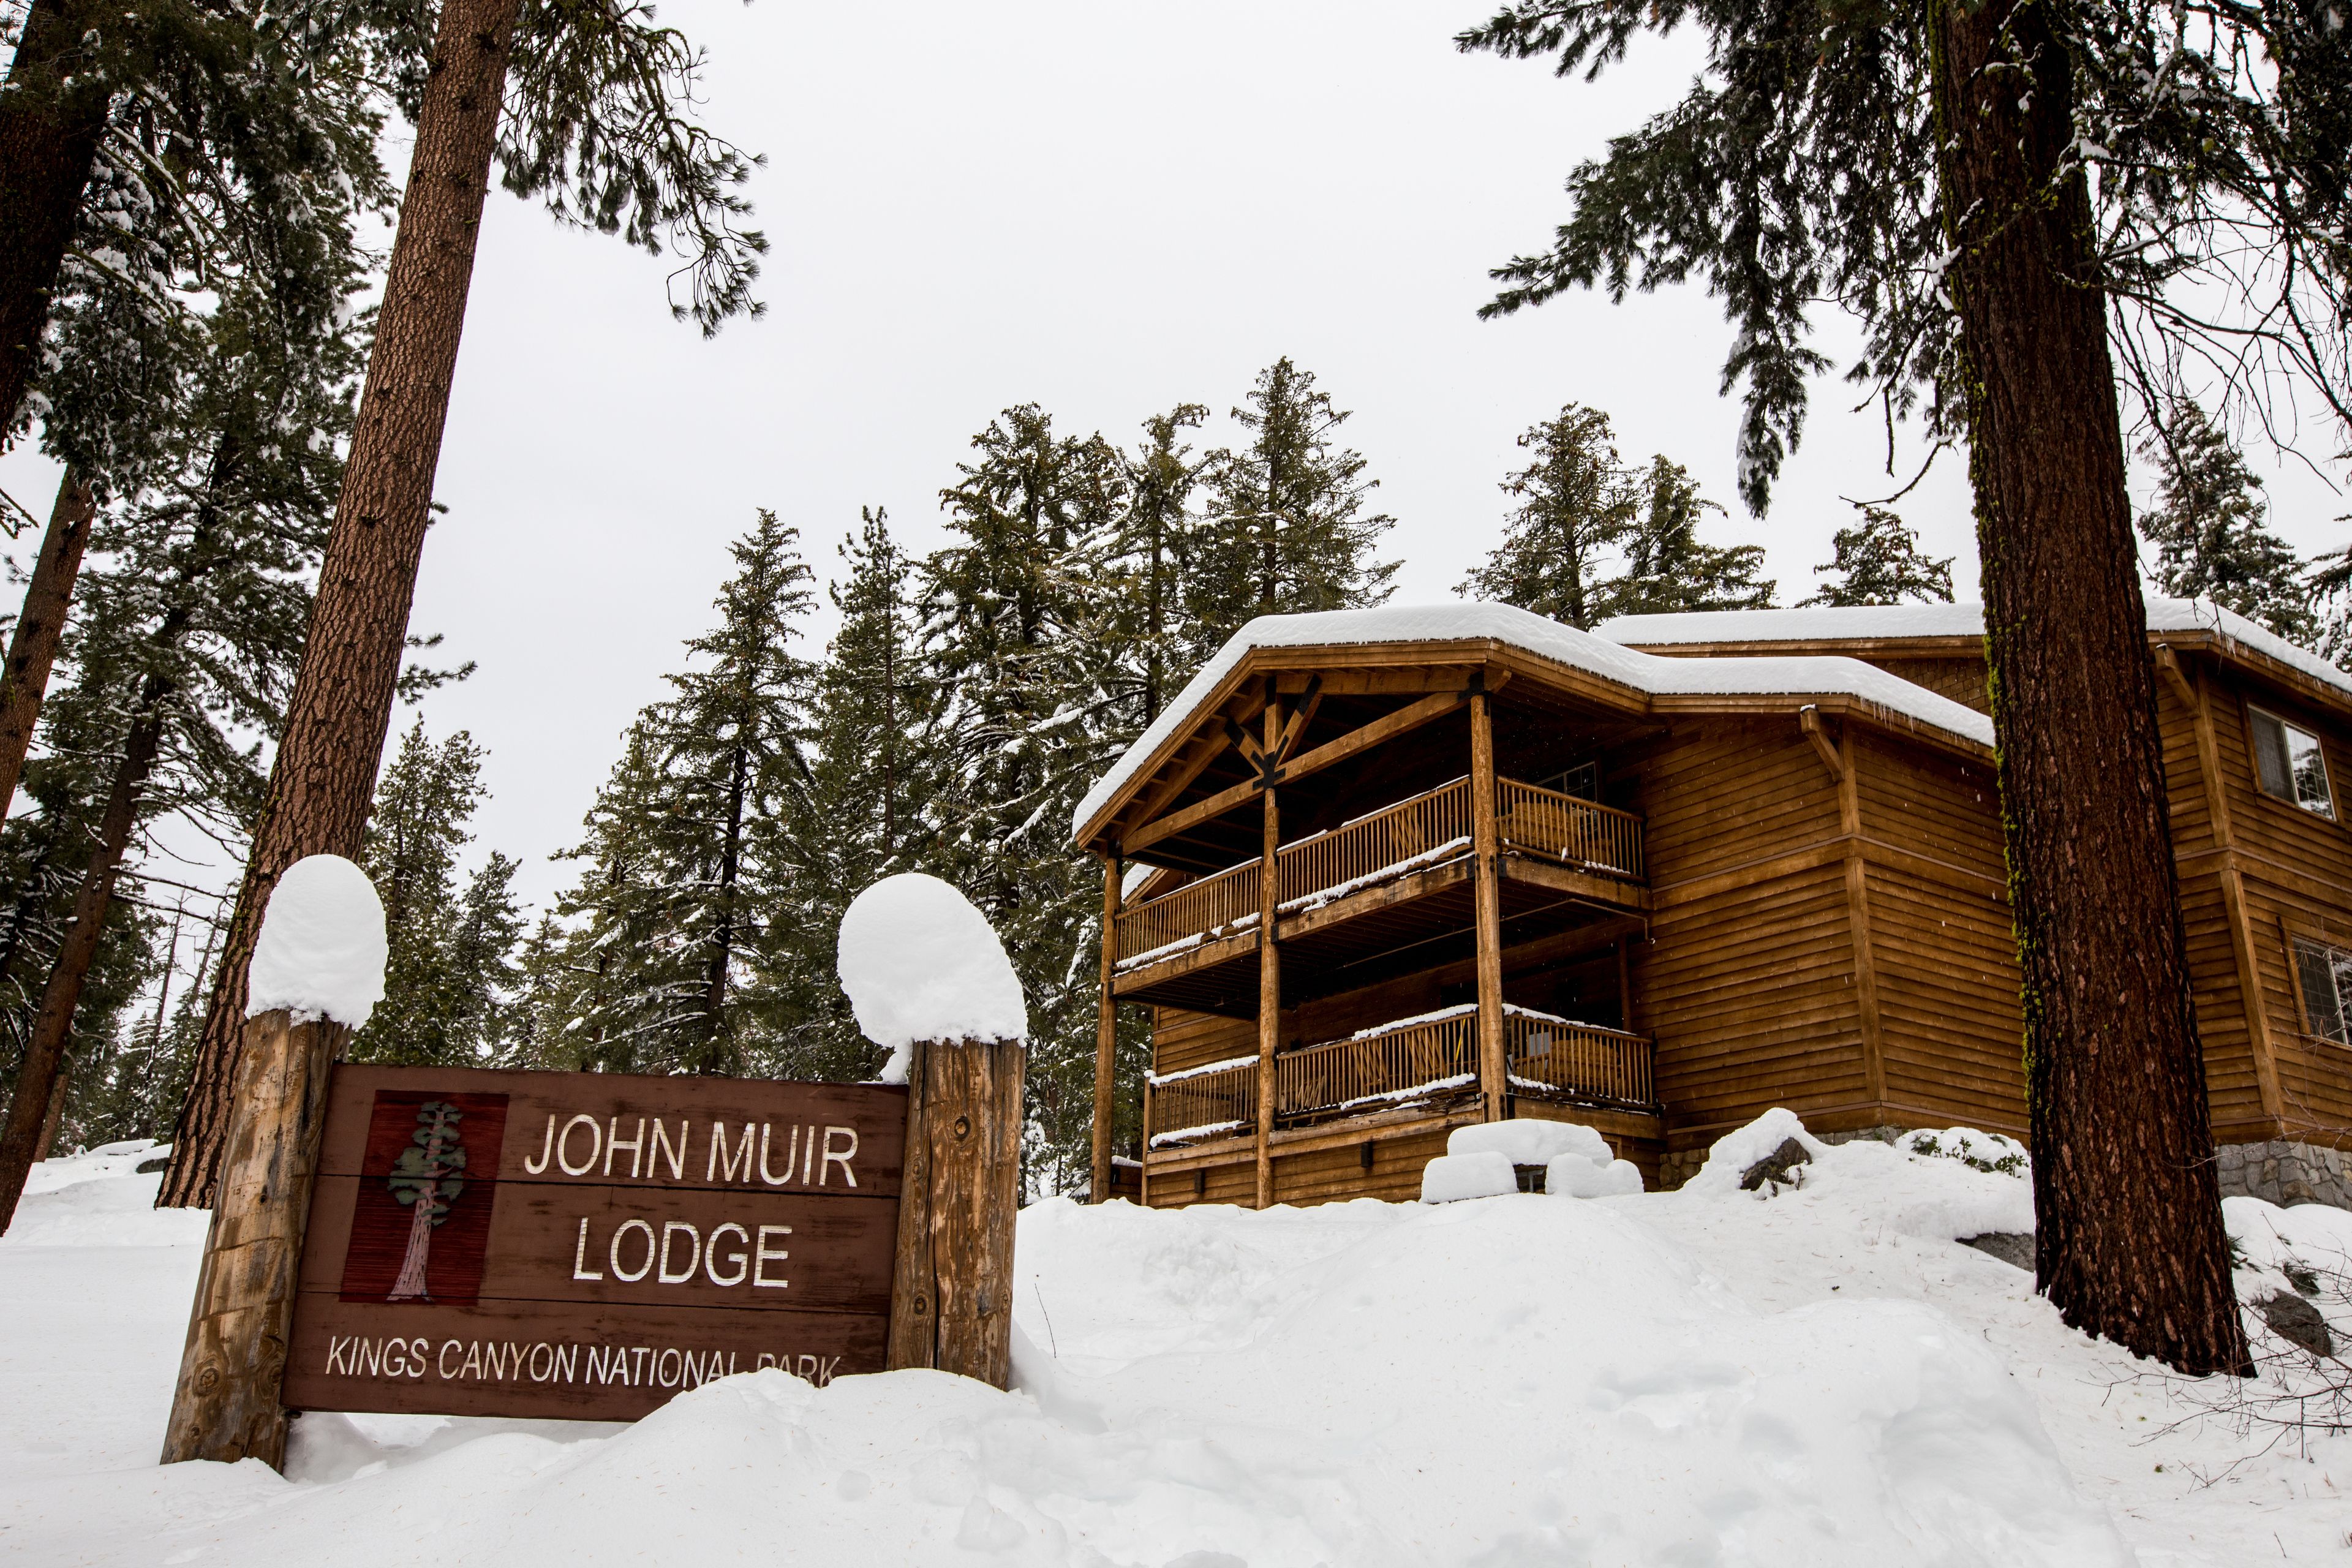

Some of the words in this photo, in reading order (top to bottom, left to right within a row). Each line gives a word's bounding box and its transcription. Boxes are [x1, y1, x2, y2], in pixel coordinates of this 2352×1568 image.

[524, 1114, 689, 1180] JOHN
[706, 1121, 859, 1188] MUIR
[573, 1217, 793, 1289] LODGE
[325, 1335, 429, 1378] KINGS
[438, 1338, 579, 1383] CANYON
